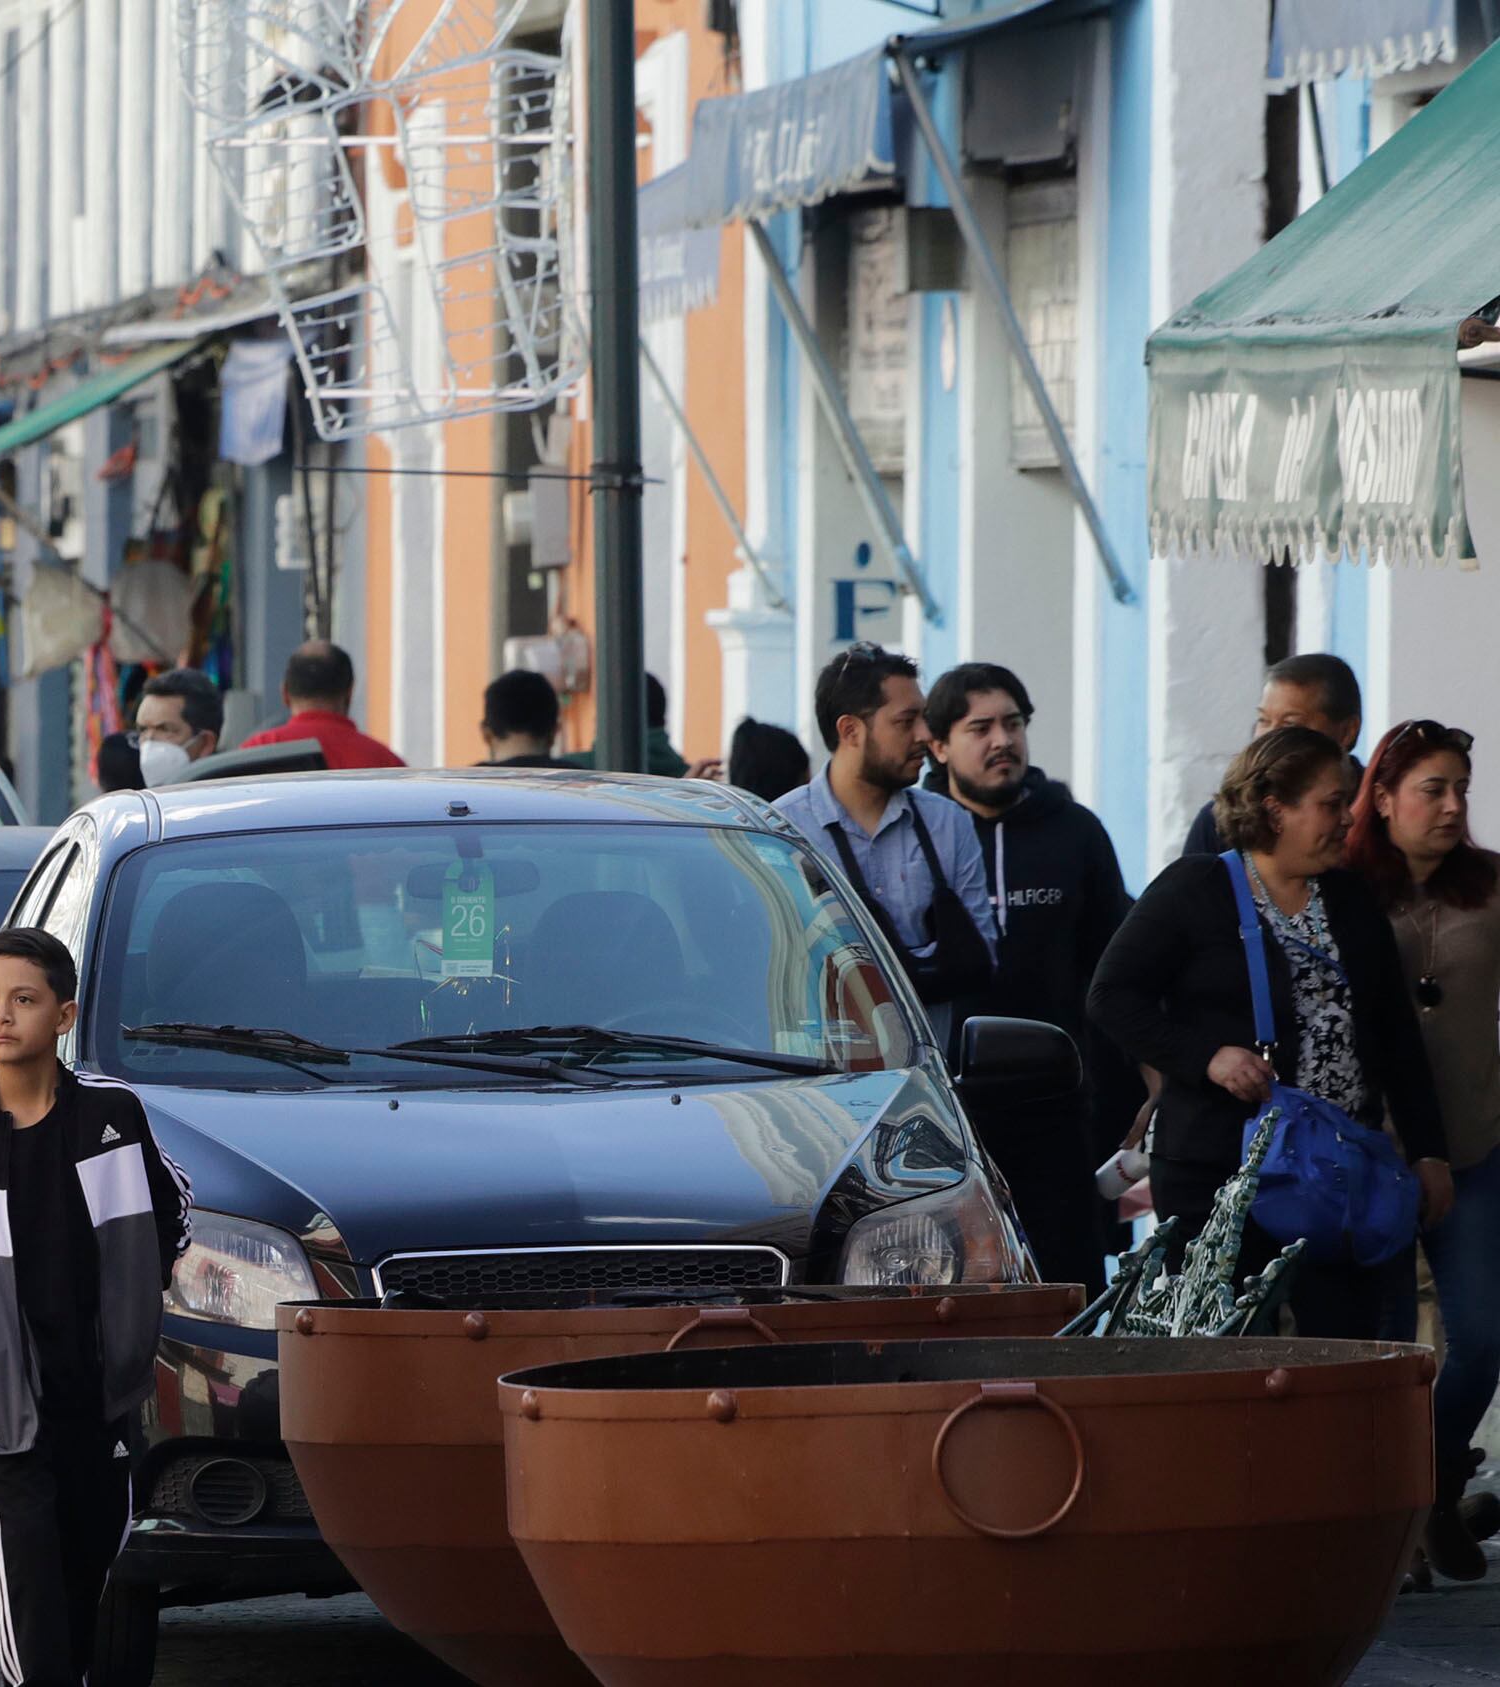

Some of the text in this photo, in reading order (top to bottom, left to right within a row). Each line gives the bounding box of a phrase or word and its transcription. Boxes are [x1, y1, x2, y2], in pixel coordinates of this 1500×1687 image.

[1275, 395, 1316, 504] del
[1007, 888, 1063, 906] HILFIGER
[451, 904, 486, 937] 26
[101, 1132, 121, 1144] adidas
